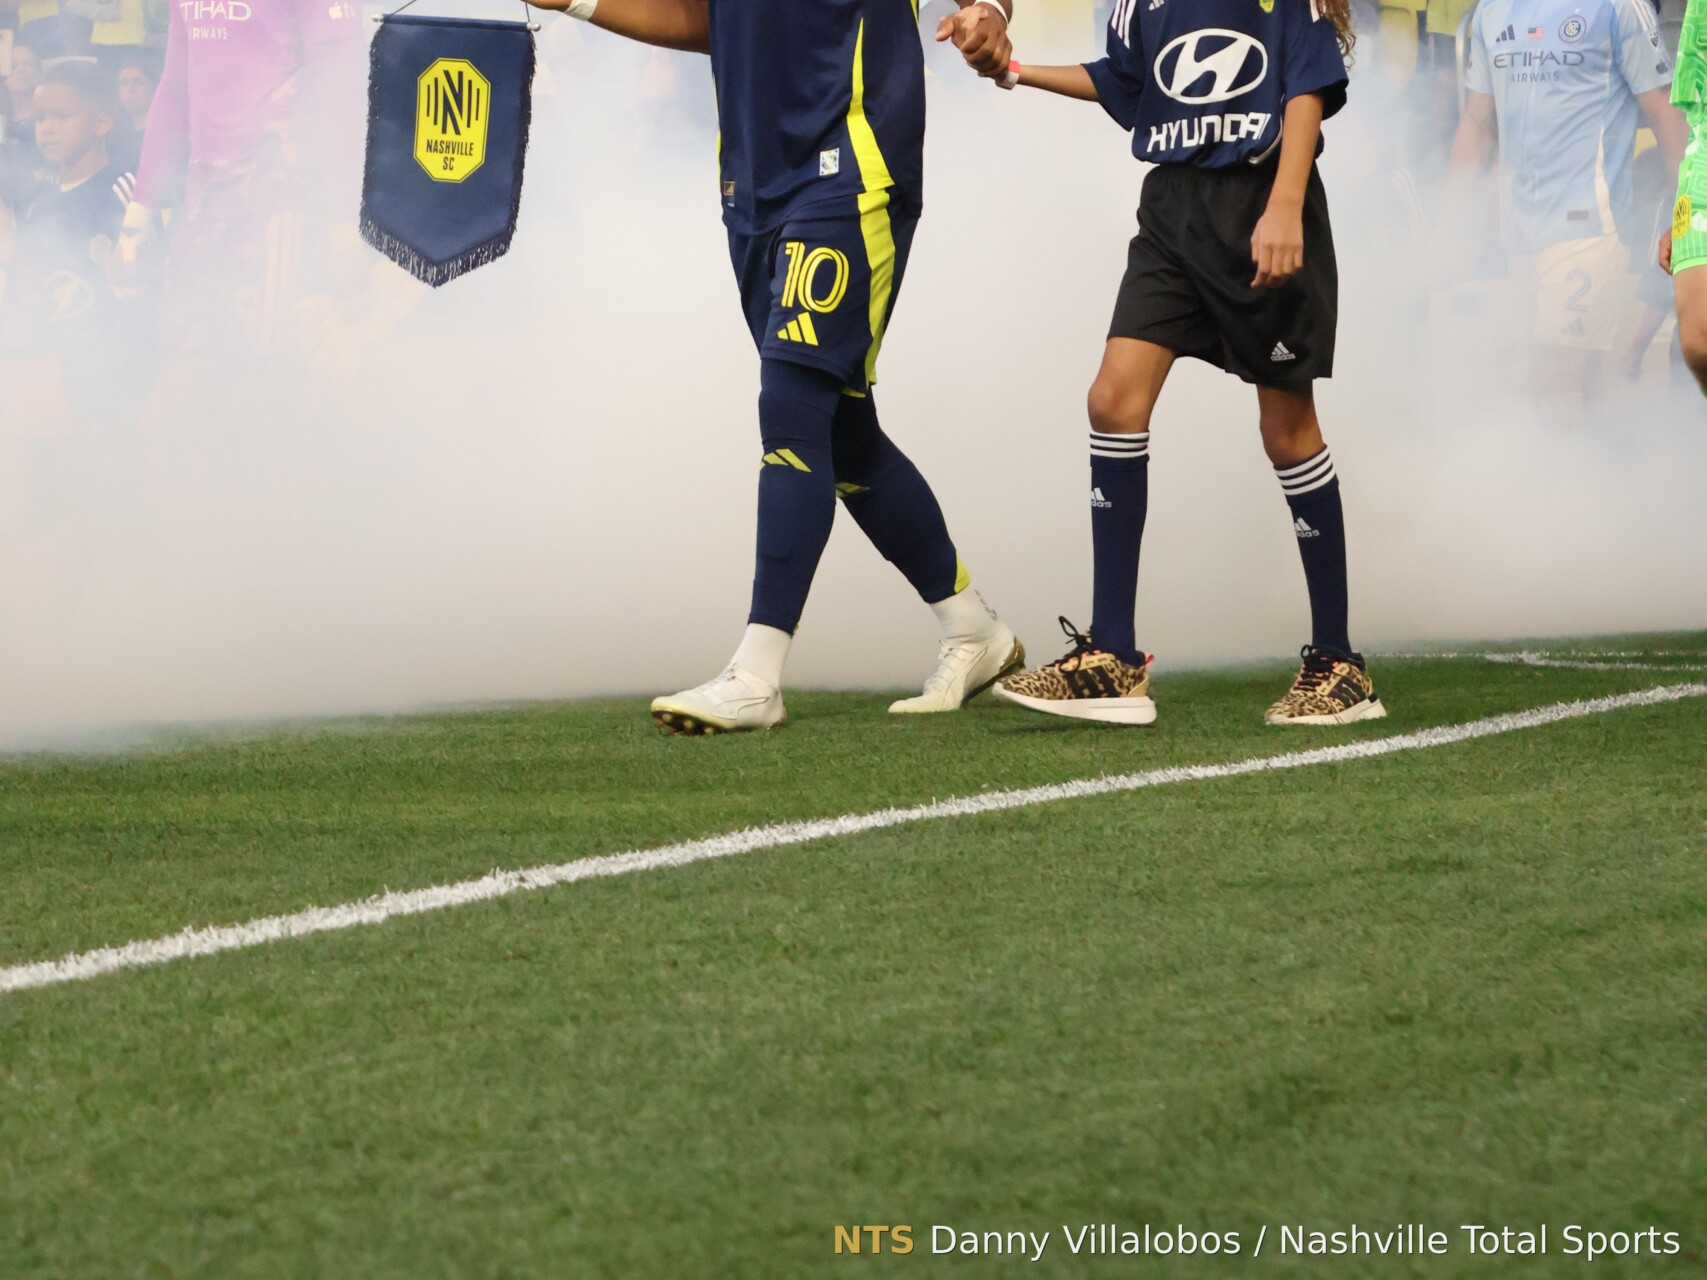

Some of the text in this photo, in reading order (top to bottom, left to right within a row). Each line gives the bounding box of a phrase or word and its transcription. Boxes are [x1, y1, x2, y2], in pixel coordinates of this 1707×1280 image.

[179, 0, 252, 21] TIHAD
[1493, 50, 1585, 69] ETIHAD
[1511, 72, 1560, 83] AIRWAYS
[1146, 111, 1272, 153] HYUNDAI
[426, 139, 474, 156] NASHVILLE
[442, 156, 455, 171] SC
[781, 241, 850, 314] 10
[1562, 268, 1592, 313] 2
